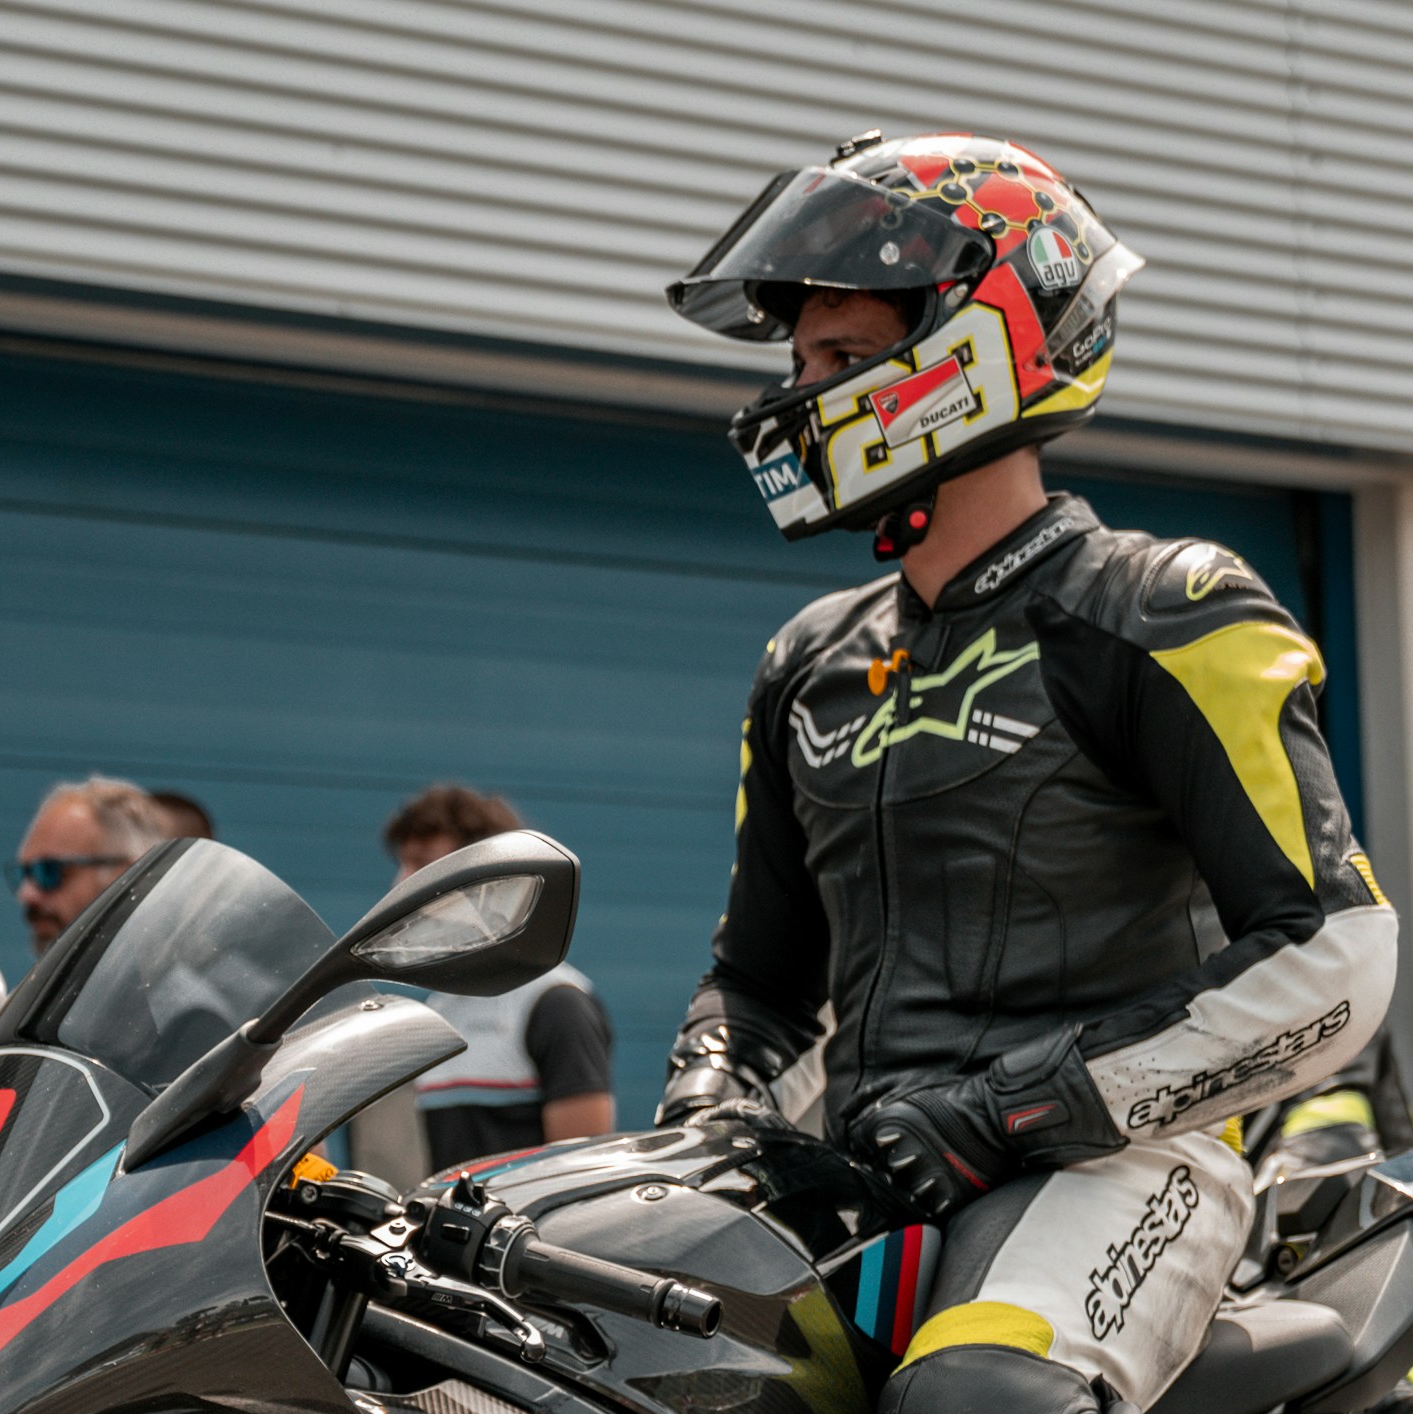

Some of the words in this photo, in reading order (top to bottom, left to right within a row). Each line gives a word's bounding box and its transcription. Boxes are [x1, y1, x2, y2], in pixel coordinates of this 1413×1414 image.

[1044, 260, 1076, 284] agv
[919, 396, 970, 429] DUCATI
[1127, 999, 1351, 1130] alpinestars
[1084, 1163, 1200, 1342] alpinestars
